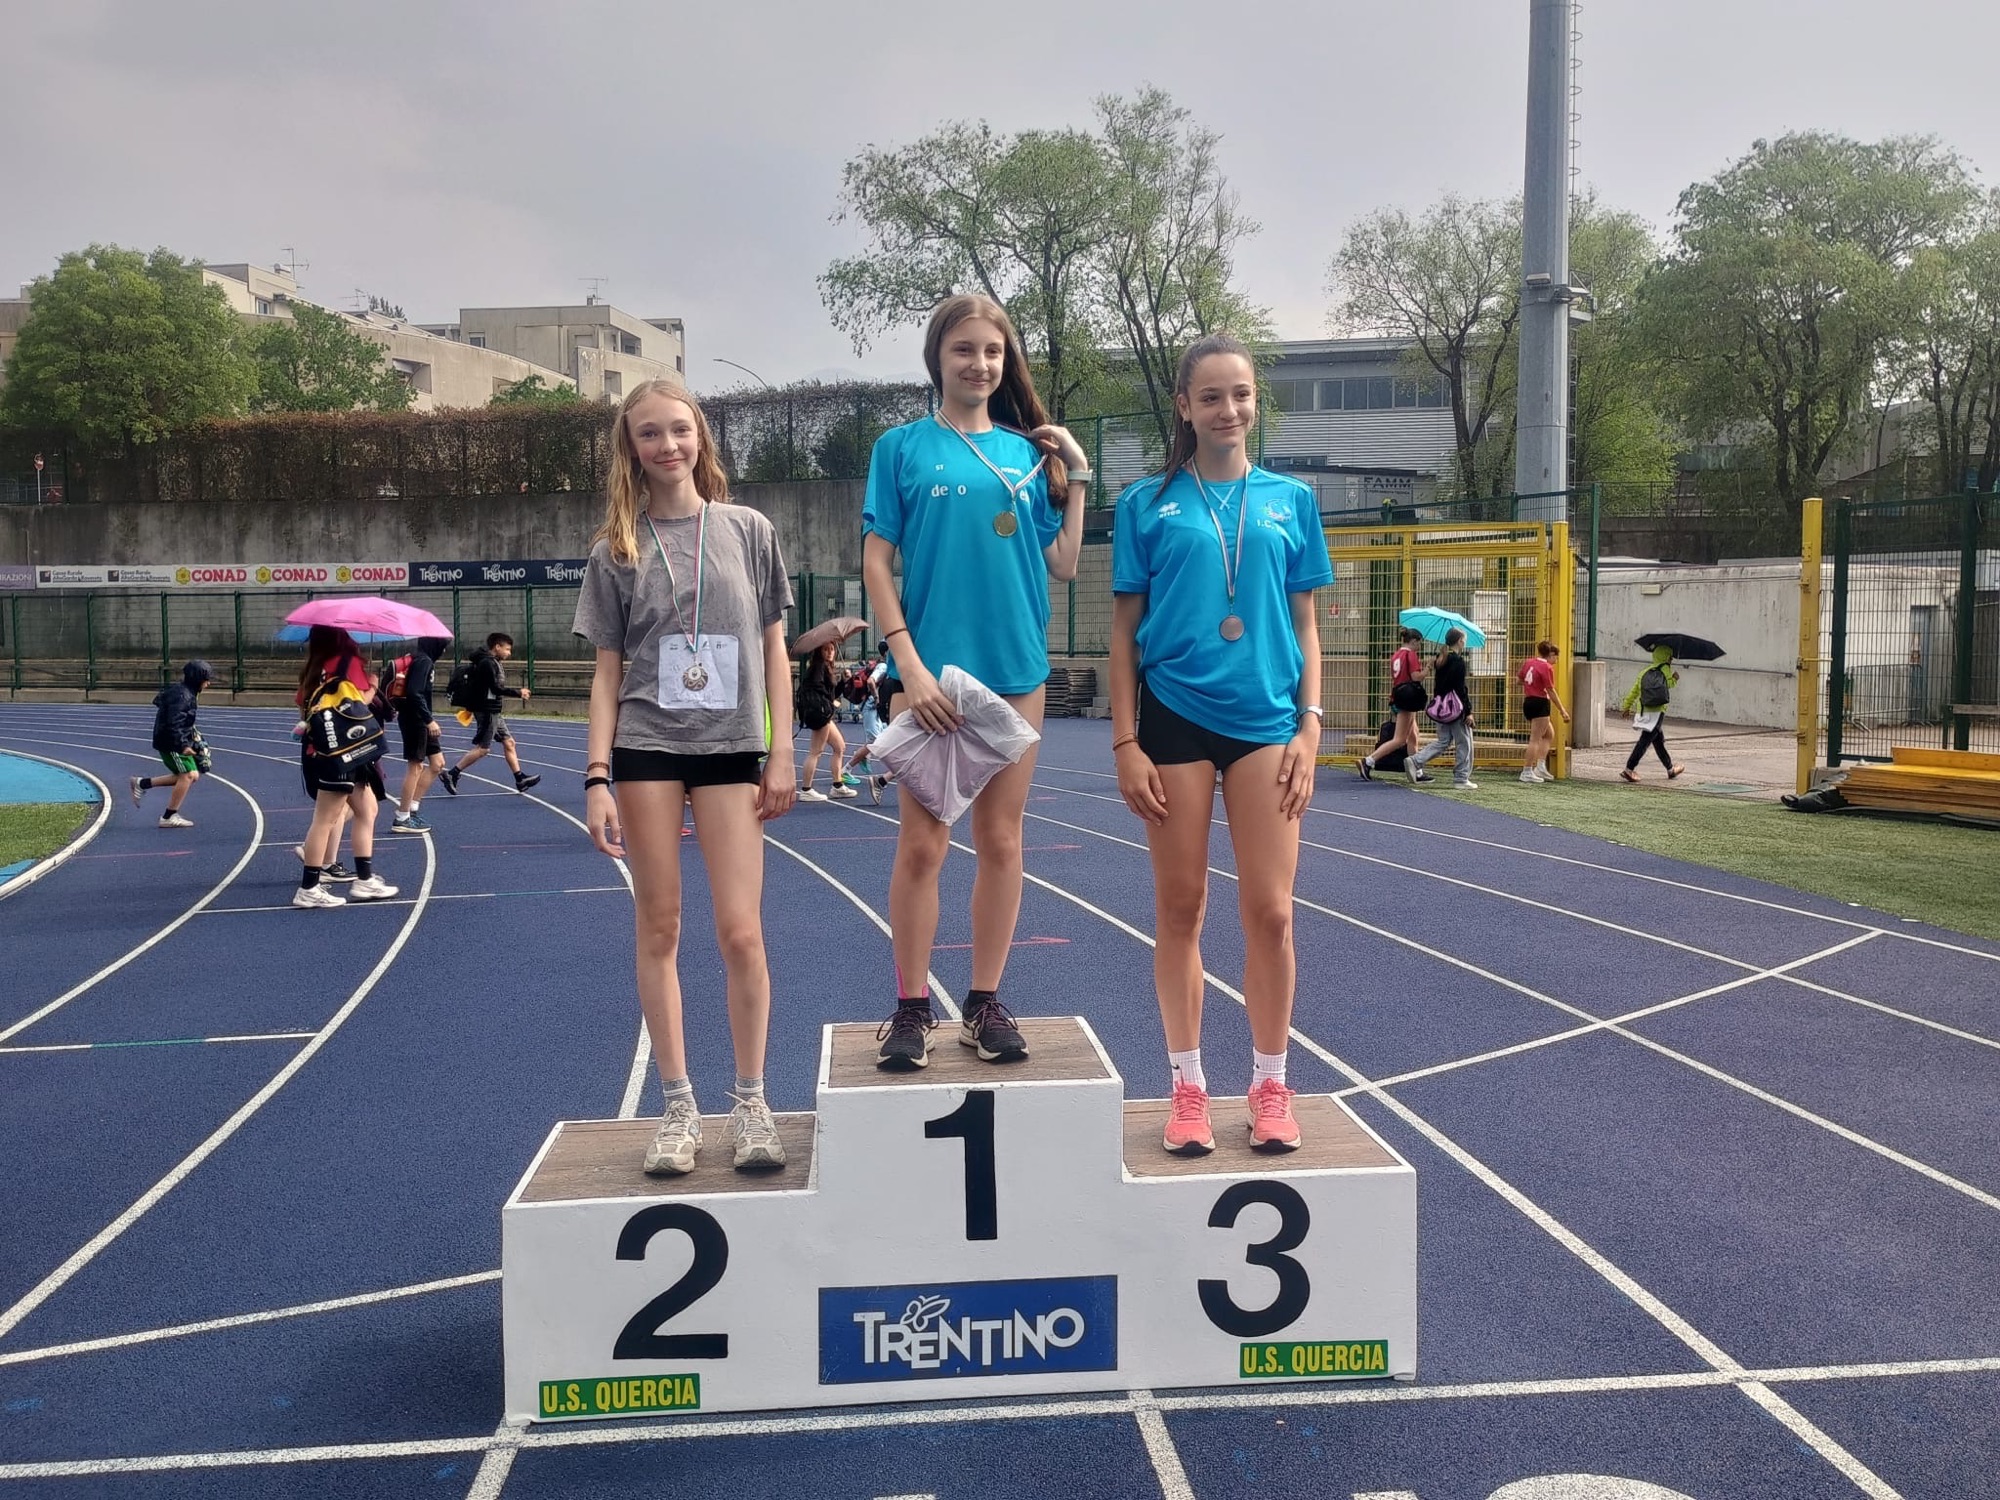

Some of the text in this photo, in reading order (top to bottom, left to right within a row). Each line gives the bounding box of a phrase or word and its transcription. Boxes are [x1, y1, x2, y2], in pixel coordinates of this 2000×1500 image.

[1363, 476, 1411, 488] FAMM
[191, 568, 247, 582] CONAD
[271, 568, 328, 582] CONAD
[351, 567, 407, 581] CONAD
[419, 567, 463, 582] TRENTINO
[481, 566, 526, 582] TRENTINO
[1393, 658, 1401, 678] 9
[924, 1090, 998, 1240] 1
[1198, 1180, 1310, 1337] 3
[613, 1203, 728, 1359] 2
[853, 1308, 1085, 1369] TRENTINO
[1243, 1344, 1385, 1375] U.S. QUERCIA
[543, 1377, 697, 1413] U.S. QUERCIA
